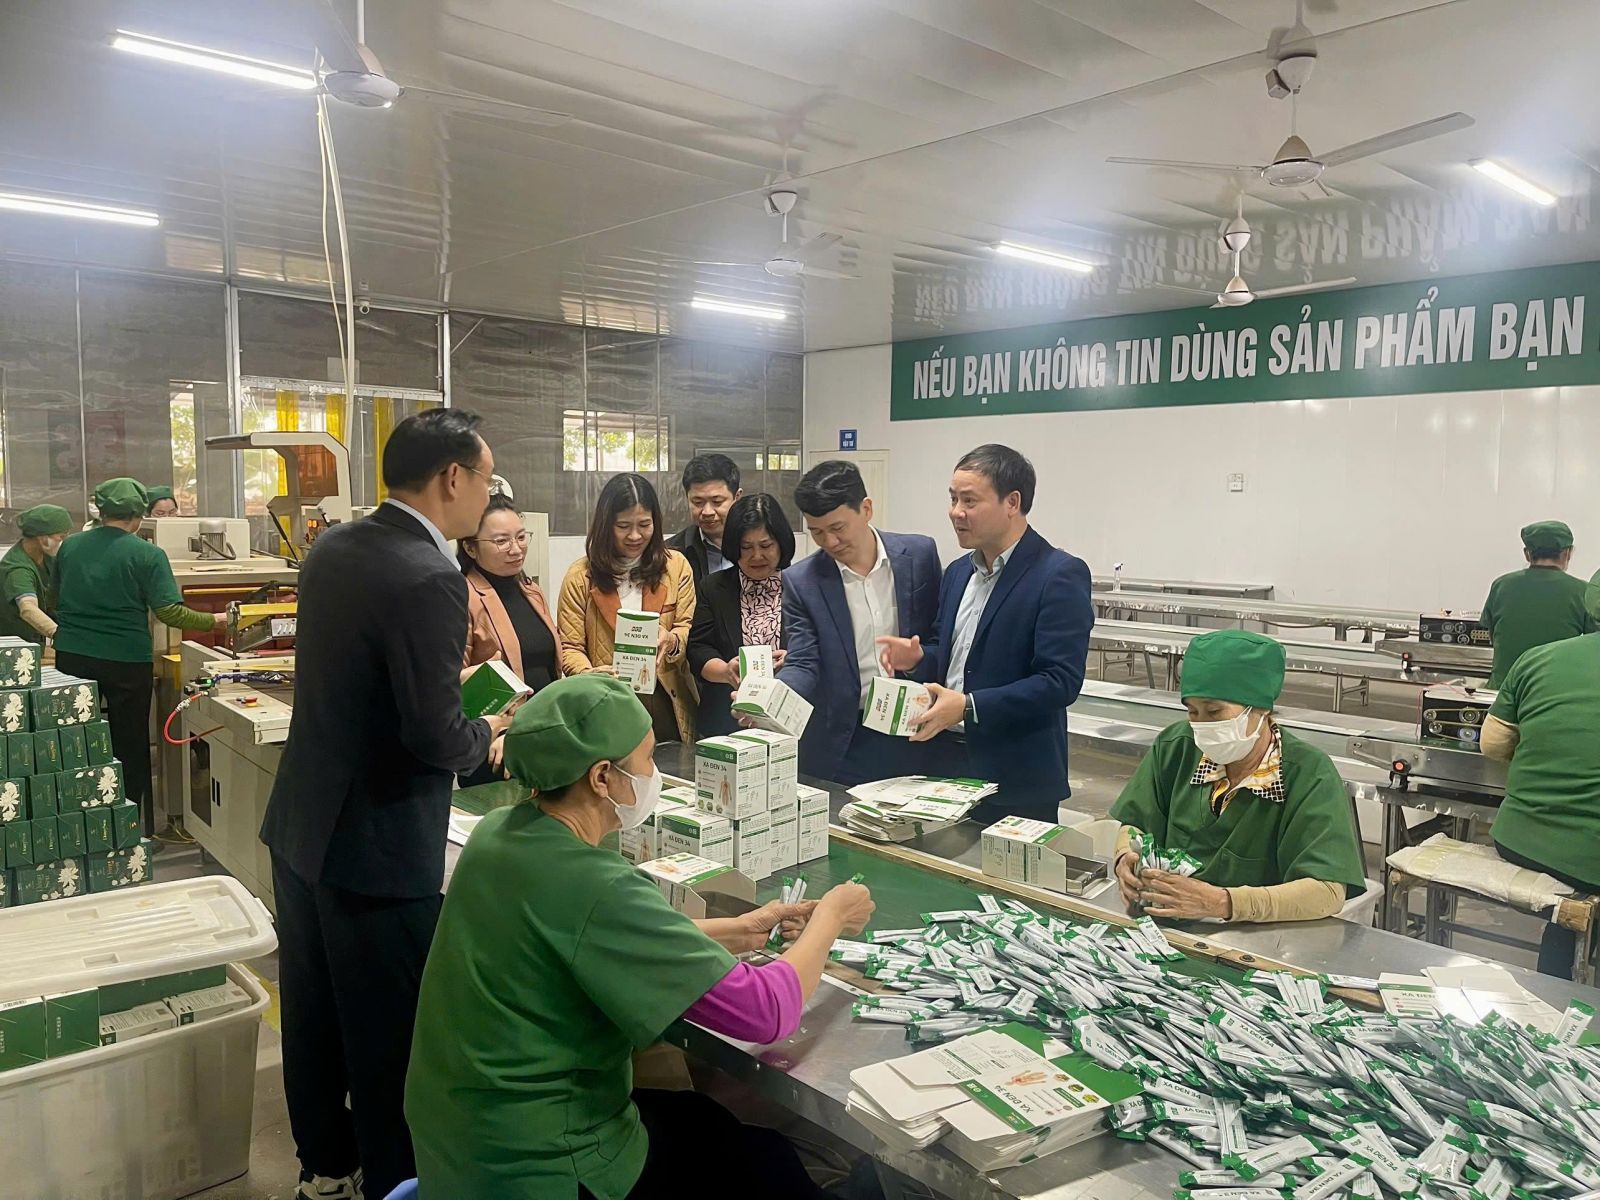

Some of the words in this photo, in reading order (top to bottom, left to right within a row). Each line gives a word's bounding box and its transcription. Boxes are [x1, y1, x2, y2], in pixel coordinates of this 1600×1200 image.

[913, 345, 957, 400] NẾU
[962, 351, 1011, 404] BẠN
[1018, 337, 1107, 393] KHÔNG
[1116, 337, 1162, 386] TIN
[1170, 323, 1258, 383] DÙNG
[1268, 304, 1344, 376] SẢN
[1354, 286, 1477, 370] PHẨM
[1489, 295, 1586, 371] BẠN
